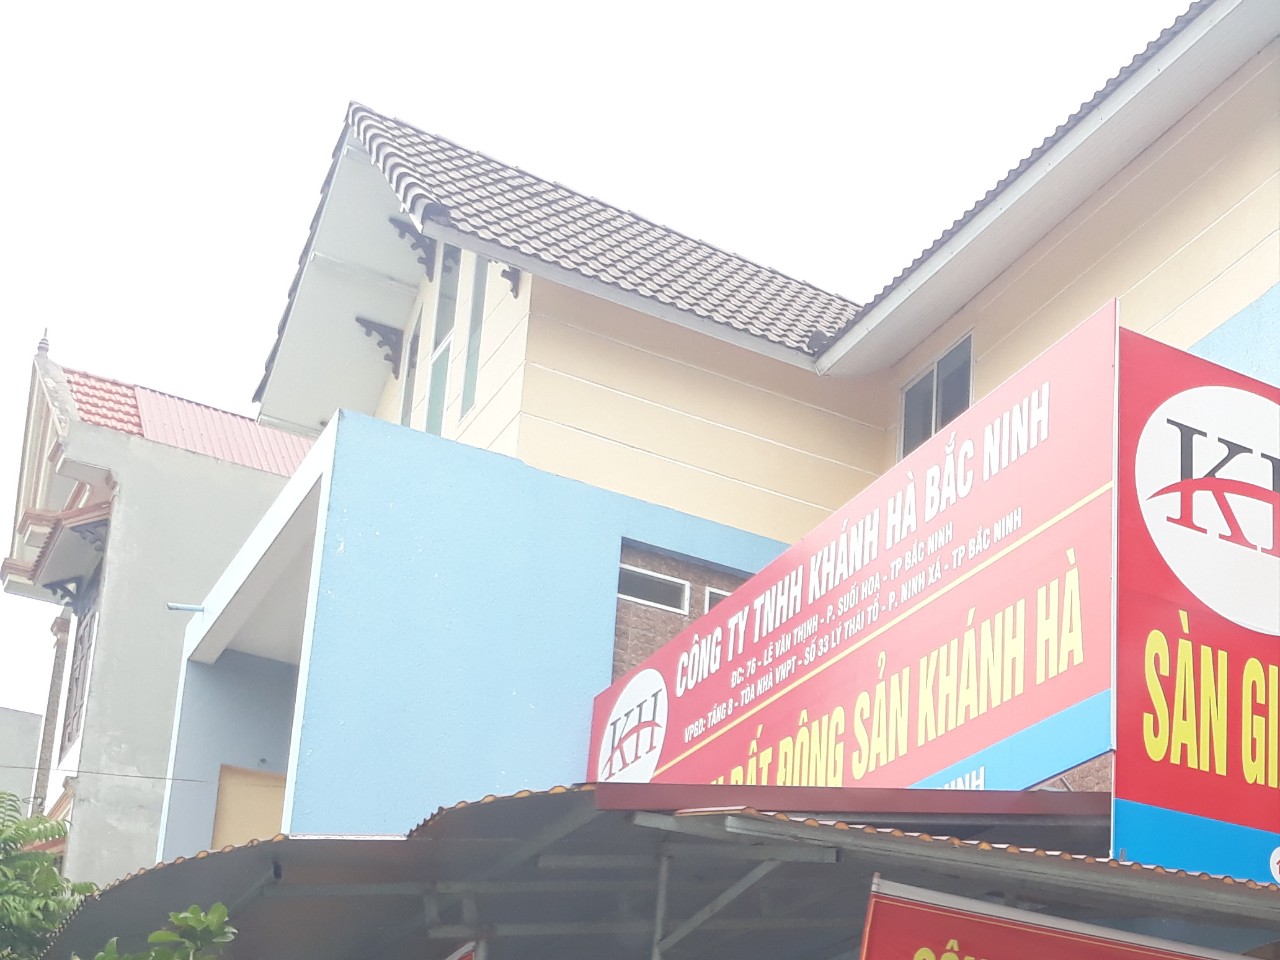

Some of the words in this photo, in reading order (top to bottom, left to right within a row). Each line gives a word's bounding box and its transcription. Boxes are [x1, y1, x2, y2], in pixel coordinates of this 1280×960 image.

[676, 632, 723, 698] CÔNG
[727, 606, 749, 662] TY
[753, 572, 803, 643] TNHH
[808, 518, 880, 604] KHÁNH
[885, 470, 917, 550] HÀ
[925, 430, 974, 524] BẮC
[982, 380, 1050, 482] NINH
[851, 650, 909, 781] SẢN
[918, 608, 1025, 748] KHÁNH
[1035, 548, 1084, 685] HÀ
[1143, 610, 1228, 777] SÀN
